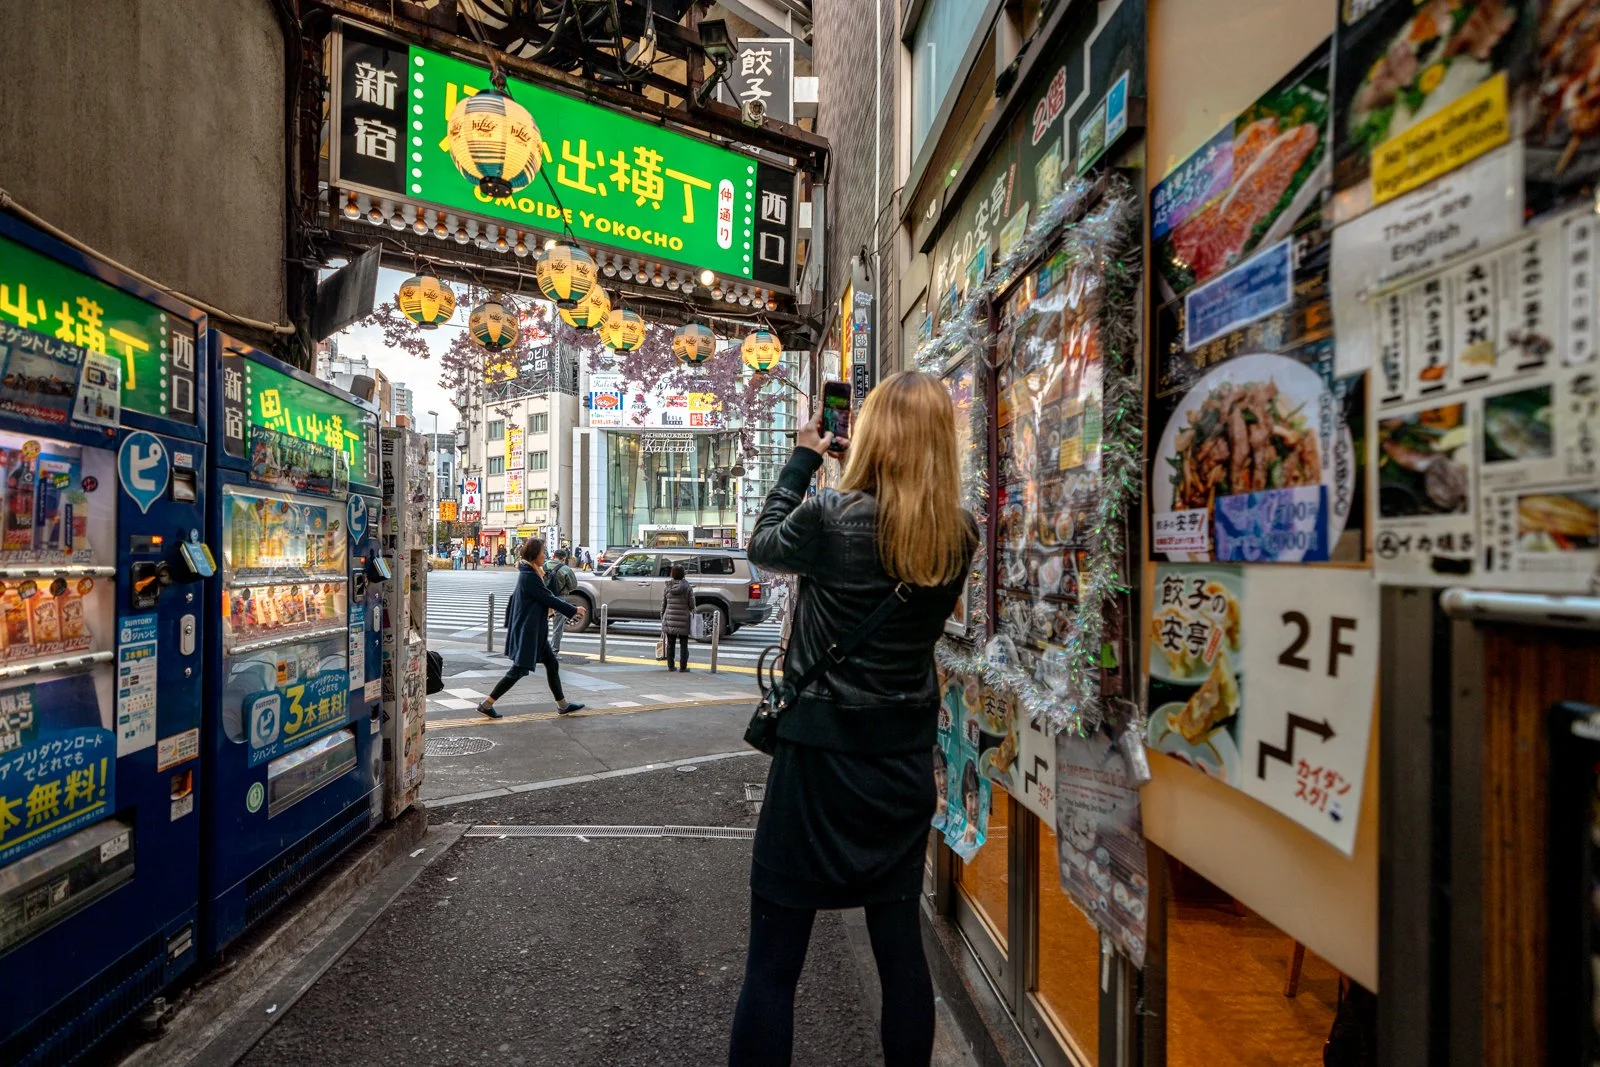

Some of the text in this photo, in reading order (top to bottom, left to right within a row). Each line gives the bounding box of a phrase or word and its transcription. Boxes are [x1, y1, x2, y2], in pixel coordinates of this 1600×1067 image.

[354, 61, 397, 163] 新宿
[1032, 66, 1066, 146] 2階
[439, 82, 712, 224] 出横丁
[579, 210, 684, 251] YOKOCHO
[719, 187, 733, 241] 仲通り
[759, 189, 787, 265] 西口
[1392, 223, 1460, 262] English
[172, 330, 194, 415] 西口
[225, 367, 243, 440] 新宿
[129, 443, 162, 491] ピ
[367, 425, 378, 476] 西口
[645, 438, 696, 453] Kaleido
[1162, 576, 1226, 613] 餃子の
[1162, 615, 1210, 655] 安亭
[1277, 610, 1358, 678] 2F
[283, 685, 347, 735] 3本無料!
[1, 734, 104, 780] アプリダウンロード
[24, 751, 84, 782] でどれでも
[1297, 759, 1352, 796] カイダン
